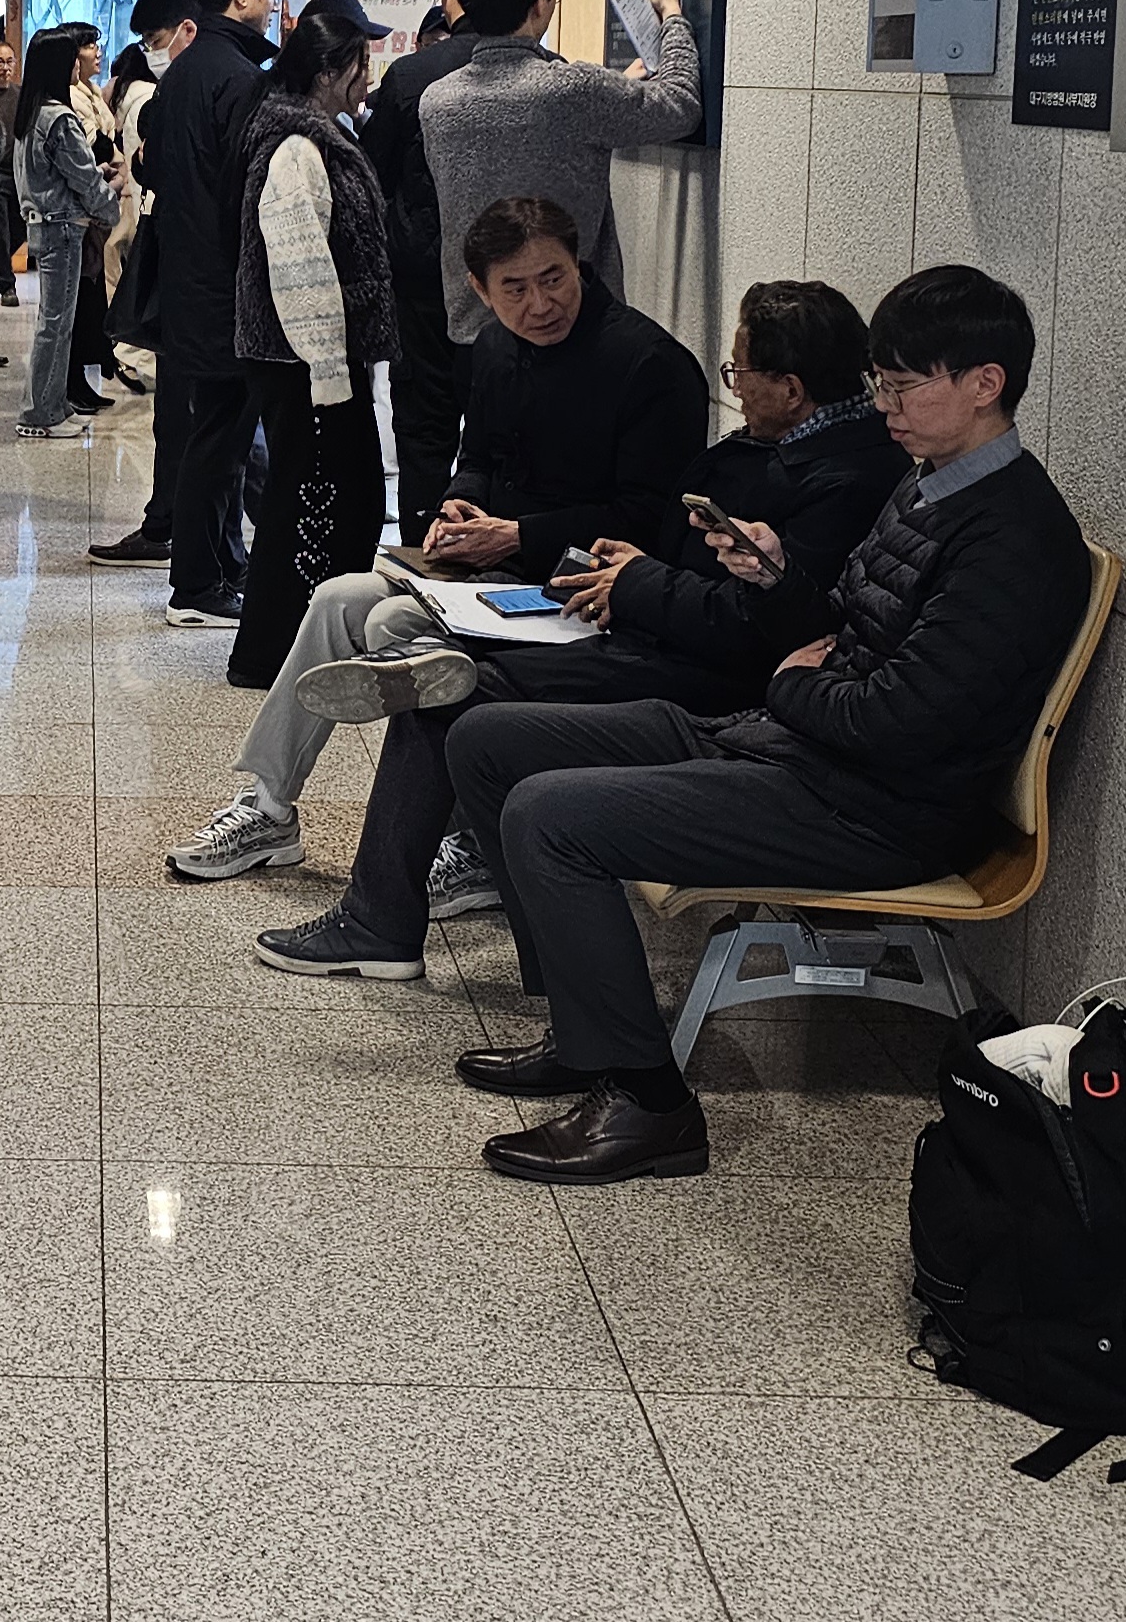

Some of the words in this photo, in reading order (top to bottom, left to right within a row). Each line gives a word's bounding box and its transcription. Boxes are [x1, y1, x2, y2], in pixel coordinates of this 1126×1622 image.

[1071, 8, 1084, 24] 넣어
[1086, 7, 1107, 23] 주시면
[1031, 31, 1053, 46] 사법제도
[1055, 31, 1065, 45] 개선
[1079, 30, 1092, 45] 적극
[1093, 29, 1106, 45] 반영
[1029, 91, 1065, 107] 대구지방법원
[1065, 92, 1098, 109] 서부지원장
[950, 1072, 999, 1107] umbro
